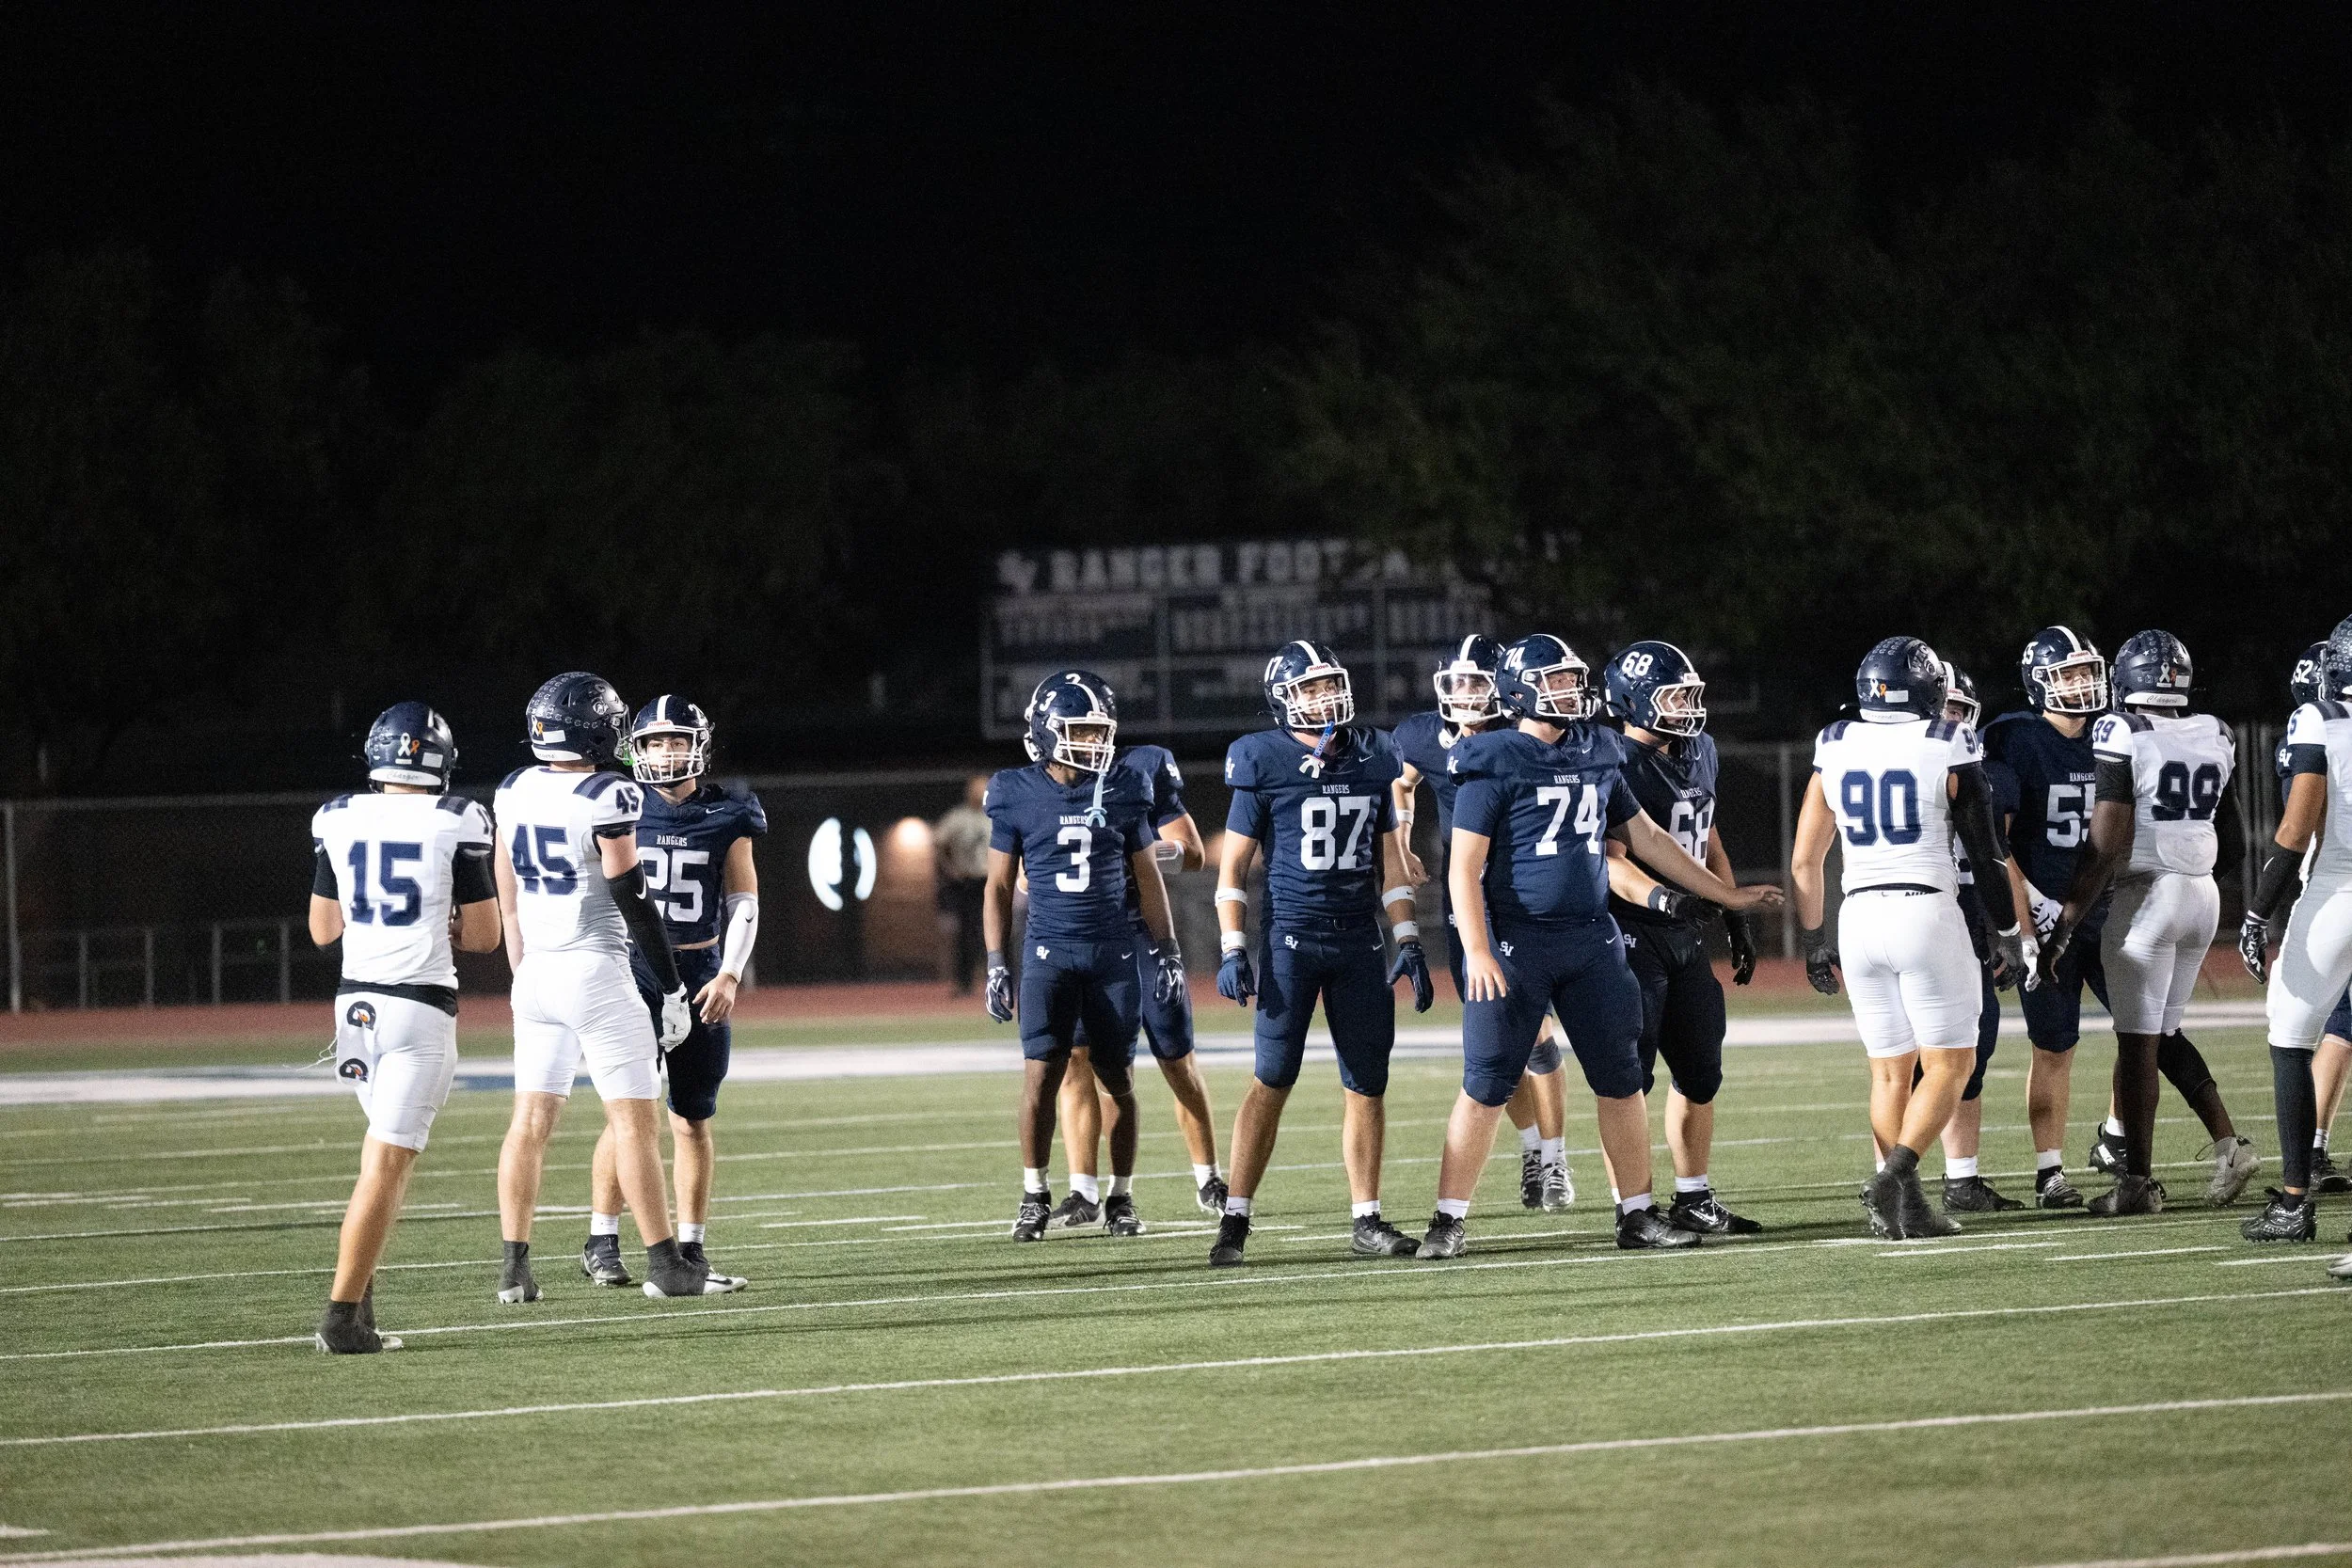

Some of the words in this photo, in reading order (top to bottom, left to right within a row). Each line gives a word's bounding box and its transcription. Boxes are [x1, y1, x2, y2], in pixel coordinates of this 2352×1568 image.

[1504, 646, 1526, 671] 74
[1621, 651, 1654, 677] 68
[2295, 659, 2314, 684] 52
[1039, 690, 1057, 712] 3
[1322, 784, 1350, 794] RANGERS
[1553, 774, 1581, 784] RANGERS
[2151, 760, 2221, 821] 99
[615, 786, 640, 816] 45
[1840, 768, 1923, 847] 90
[1059, 816, 1089, 825] RANGERS
[1300, 796, 1371, 870] 87
[1535, 784, 1601, 856] 74
[1668, 797, 1716, 867] 68
[656, 834, 688, 847] RANGERS
[511, 822, 578, 895] 45
[1055, 826, 1092, 893] 3
[347, 839, 423, 927] 15
[636, 847, 710, 923] 25
[1499, 941, 1515, 957] SV
